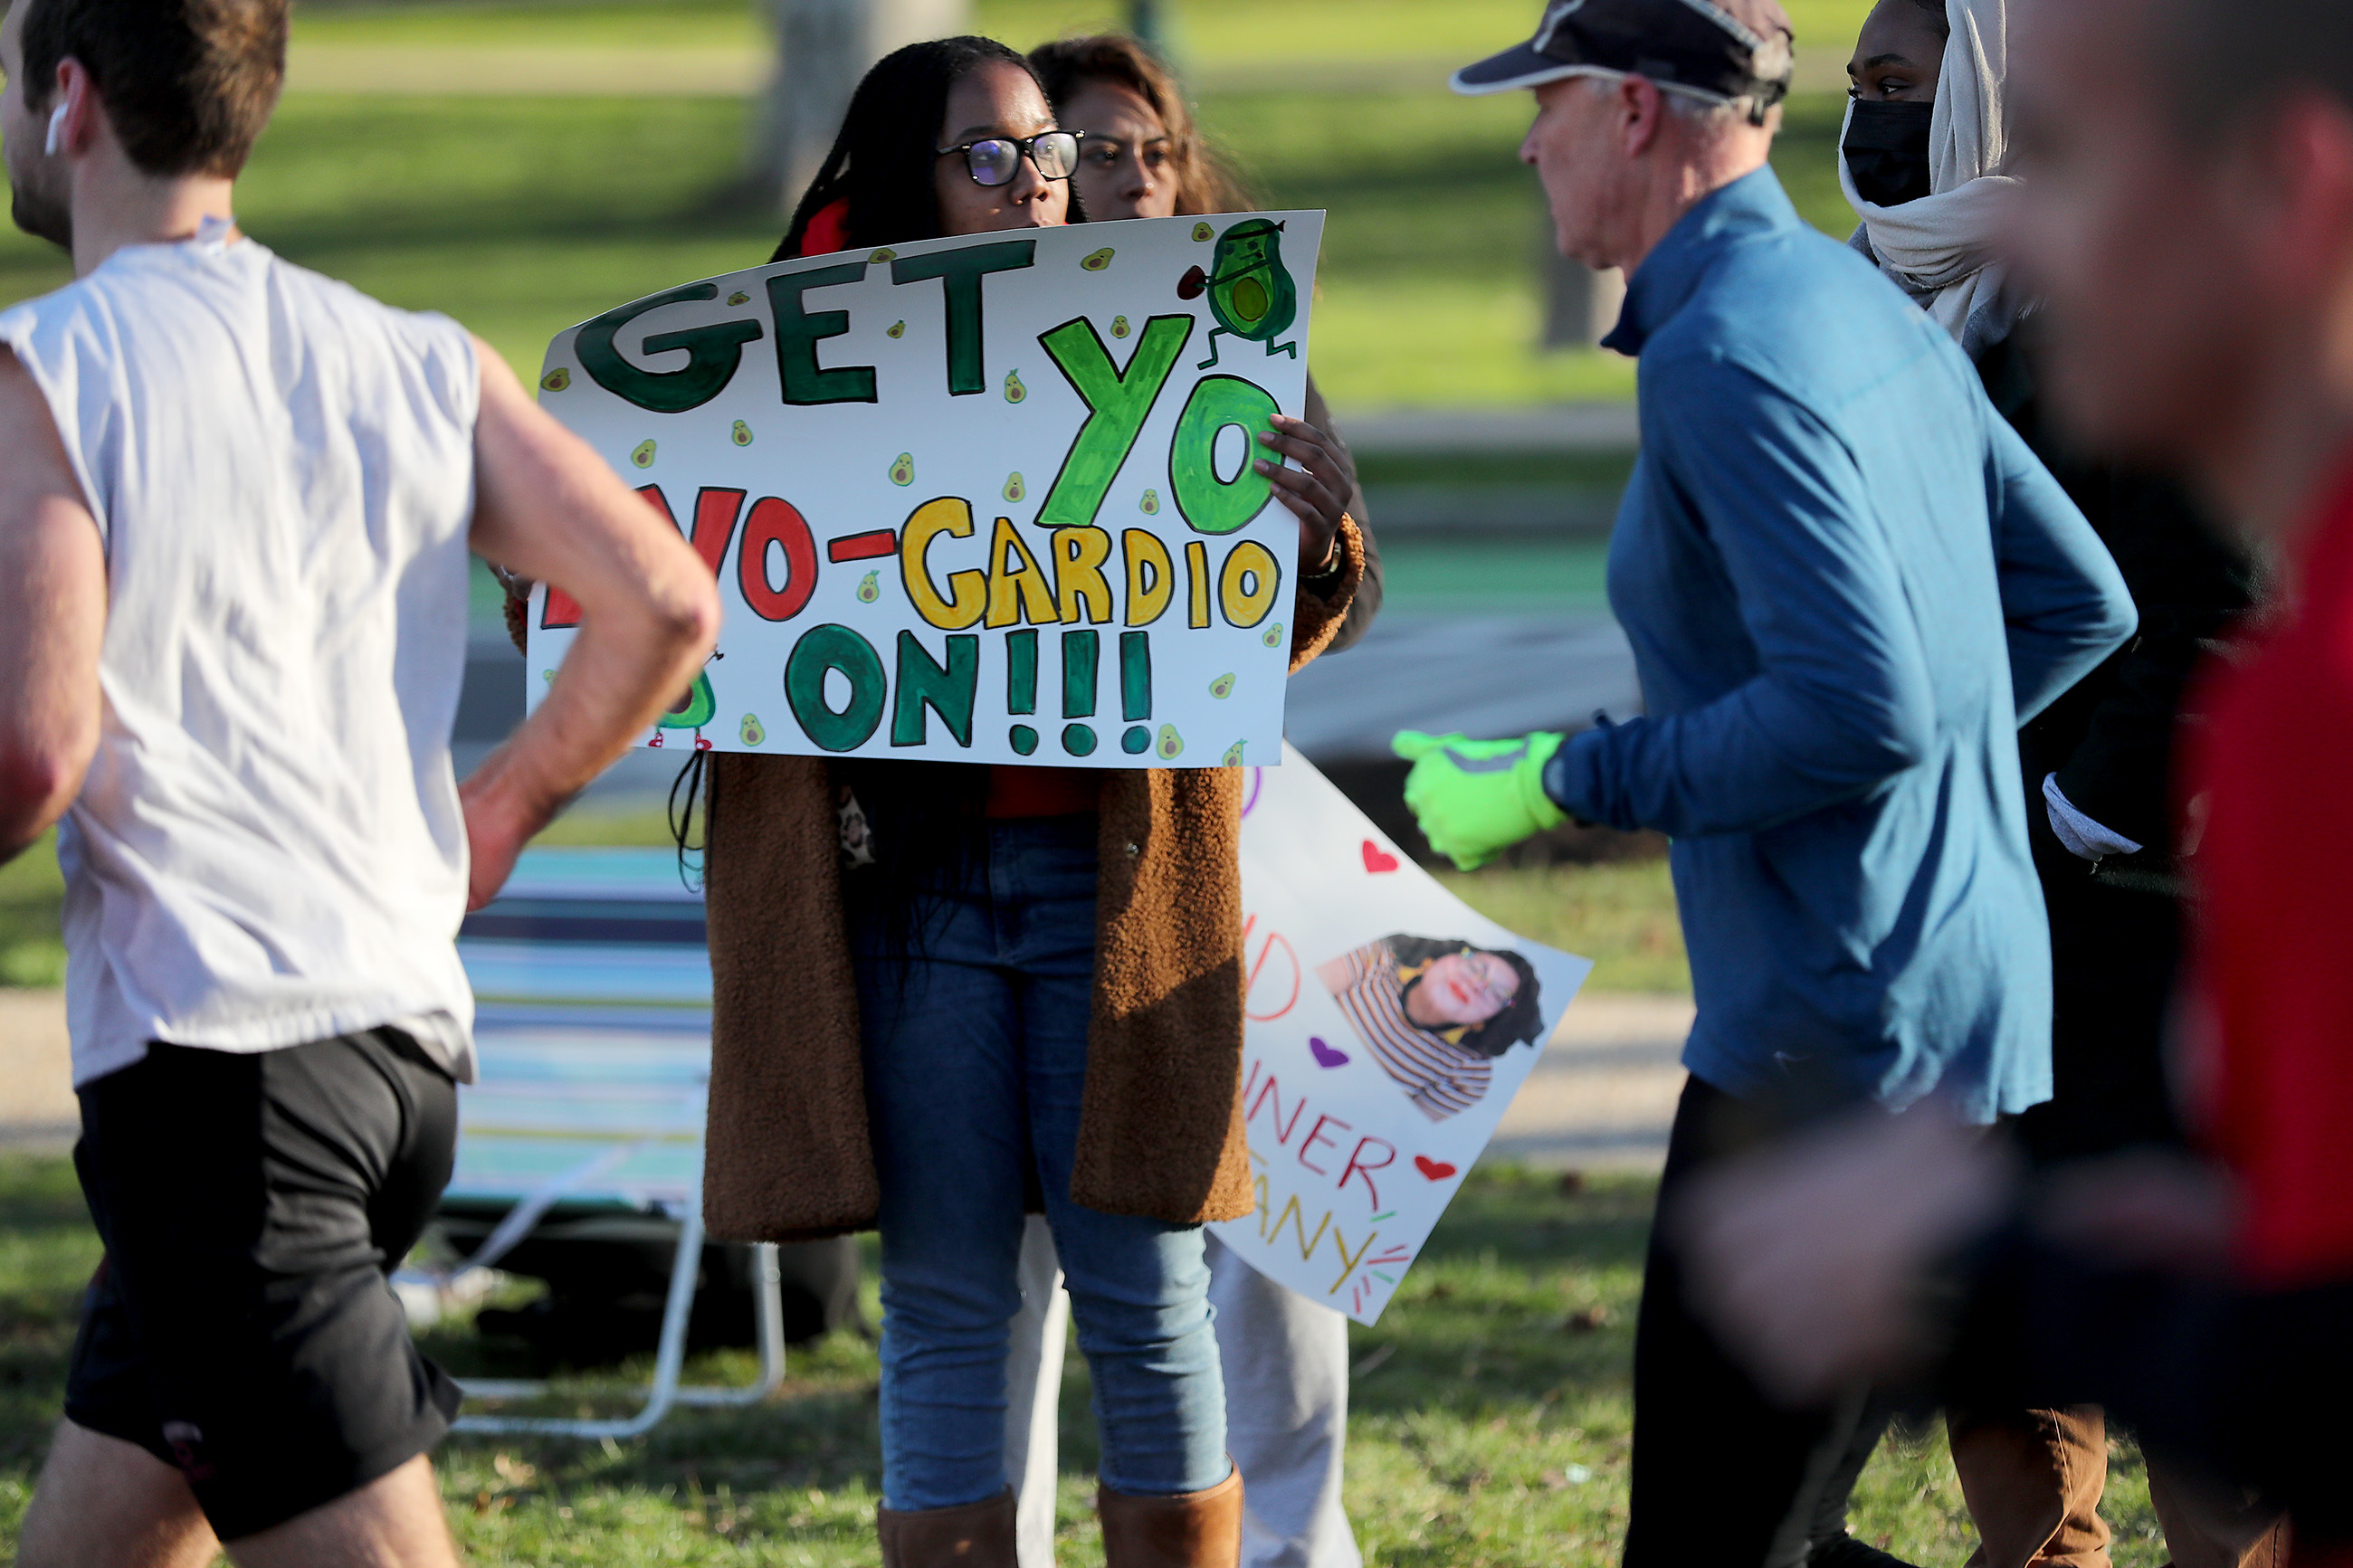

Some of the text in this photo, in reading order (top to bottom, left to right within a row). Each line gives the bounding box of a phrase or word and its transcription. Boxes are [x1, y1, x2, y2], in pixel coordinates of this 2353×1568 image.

[575, 239, 1036, 413] GET
[1034, 313, 1284, 535] YO
[784, 622, 1153, 756] ON!!!
